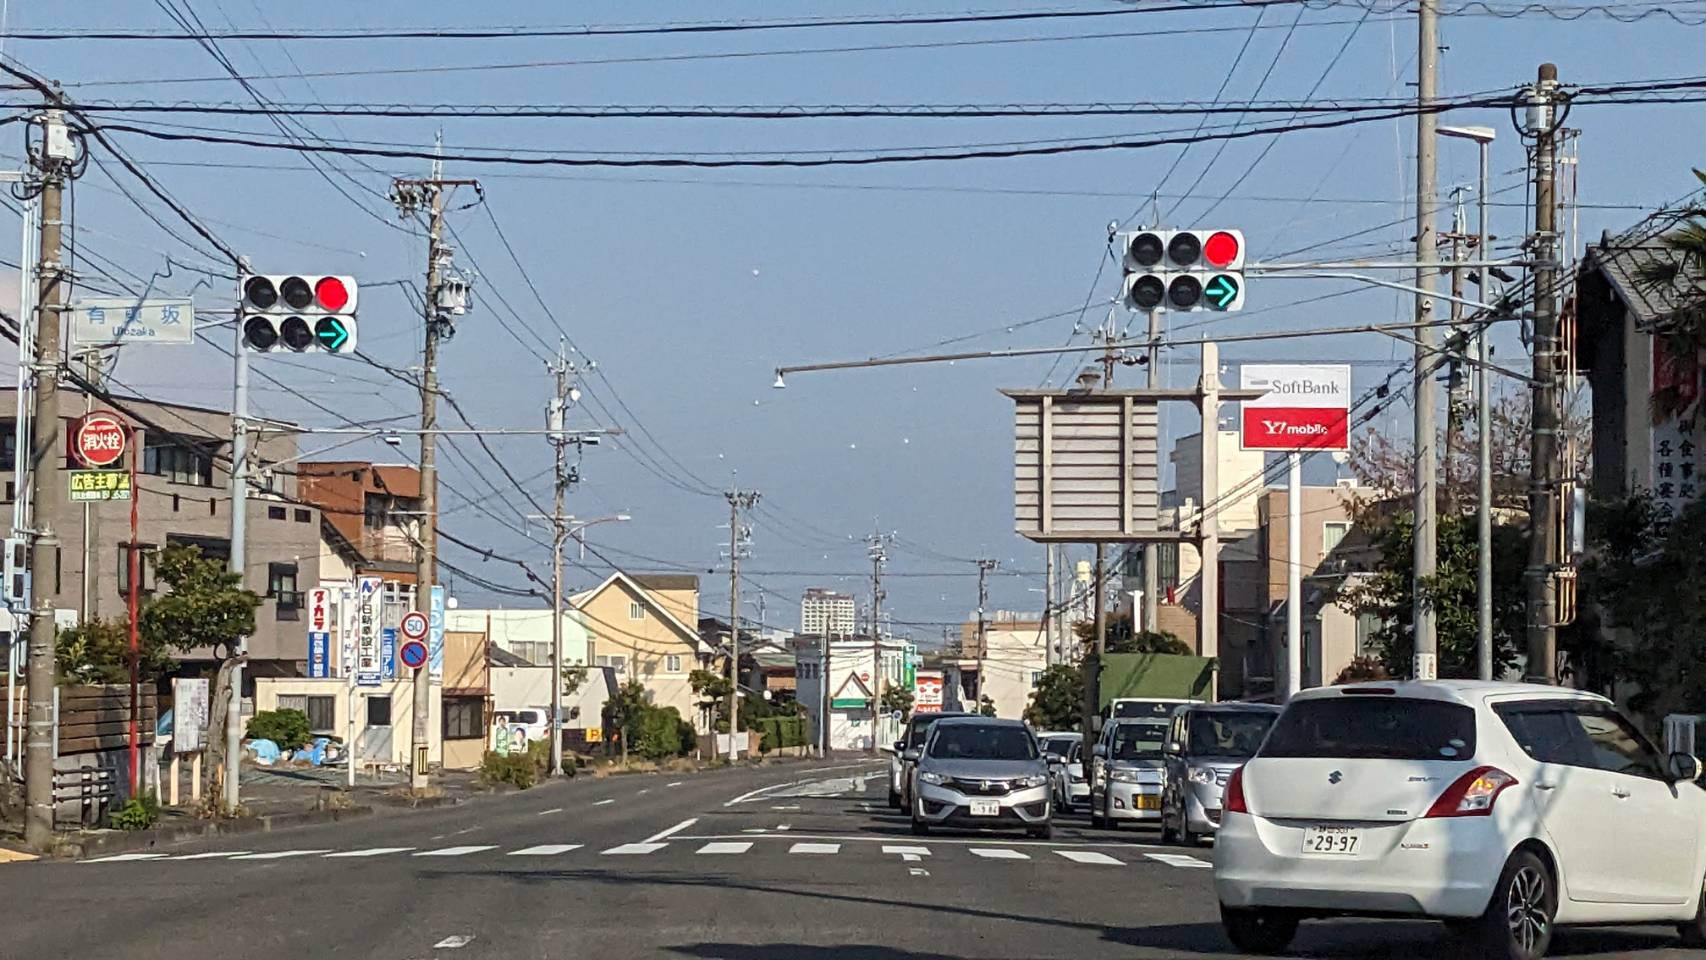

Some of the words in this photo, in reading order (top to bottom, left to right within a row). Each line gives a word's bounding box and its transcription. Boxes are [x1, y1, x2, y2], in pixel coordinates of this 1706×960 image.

[1271, 379, 1340, 395] SoftBank
[83, 432, 121, 451] 消火栓
[313, 591, 325, 630] タカラ
[407, 619, 423, 632] 50
[591, 729, 599, 740] P
[1314, 835, 1358, 852] 29-97
